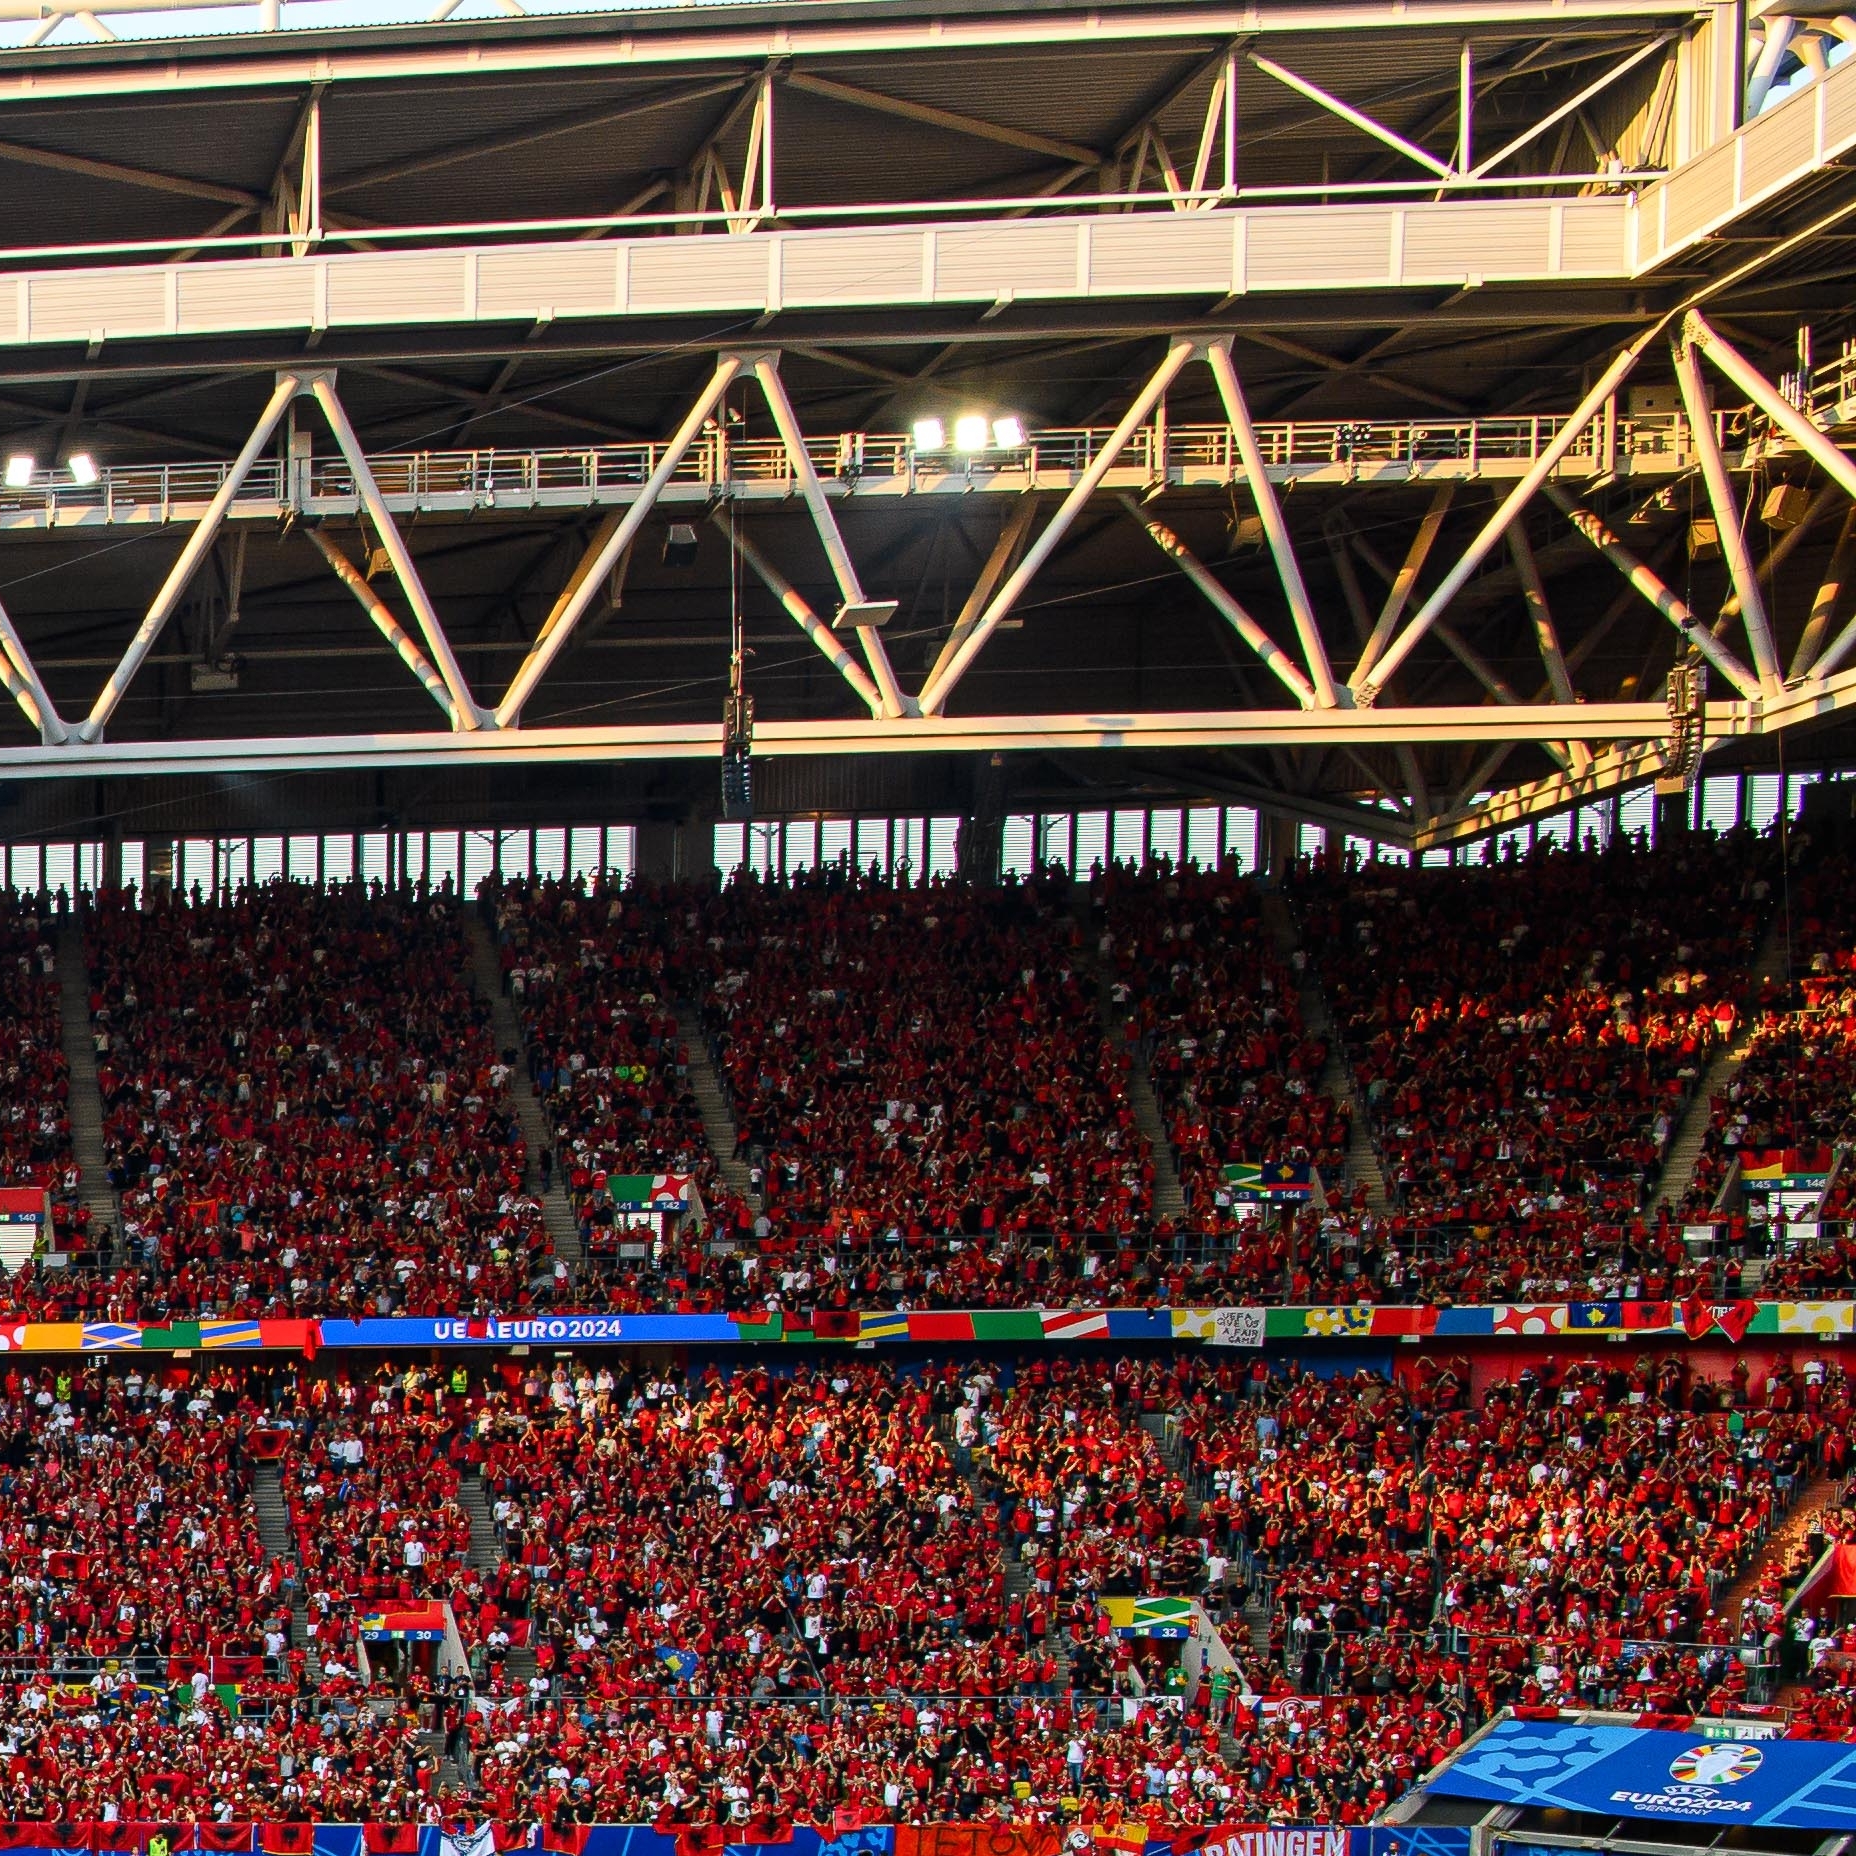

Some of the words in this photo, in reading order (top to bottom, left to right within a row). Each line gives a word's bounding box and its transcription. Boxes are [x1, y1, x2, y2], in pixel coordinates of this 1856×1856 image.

[434, 1319, 622, 1340] UEAEURO2024
[1609, 1790, 1754, 1812] EURO2024
[1633, 1803, 1713, 1816] GERMANY
